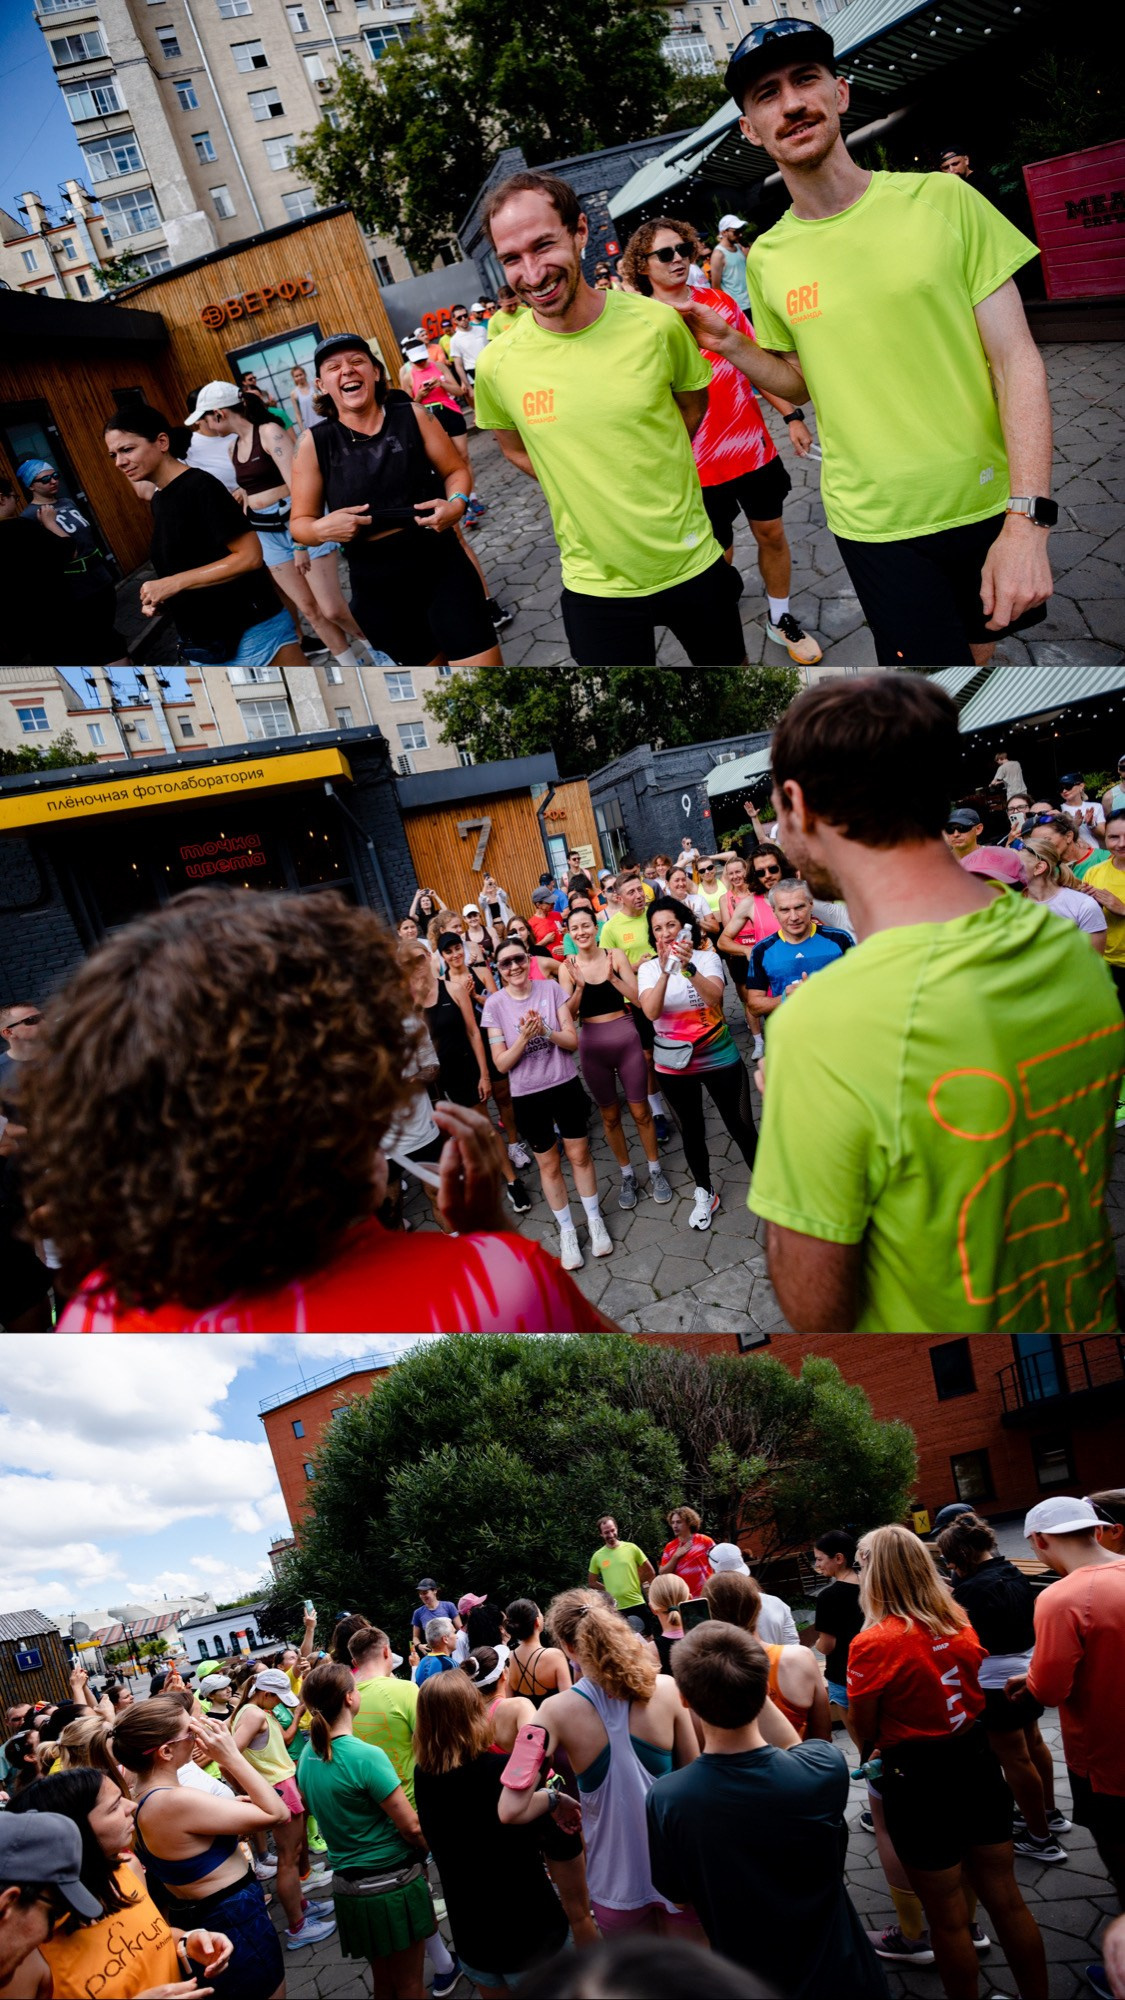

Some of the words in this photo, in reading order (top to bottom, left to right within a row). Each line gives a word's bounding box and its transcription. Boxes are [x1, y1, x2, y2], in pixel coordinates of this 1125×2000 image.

[786, 281, 819, 316] GRi
[522, 388, 555, 417] GRi
[46, 788, 129, 812] плёночная
[132, 768, 265, 800] фотолаборатория
[681, 793, 692, 818] 9
[180, 834, 261, 860] точка
[456, 815, 493, 872] 7
[185, 852, 267, 878] цвета
[25, 1655, 32, 1665] 1
